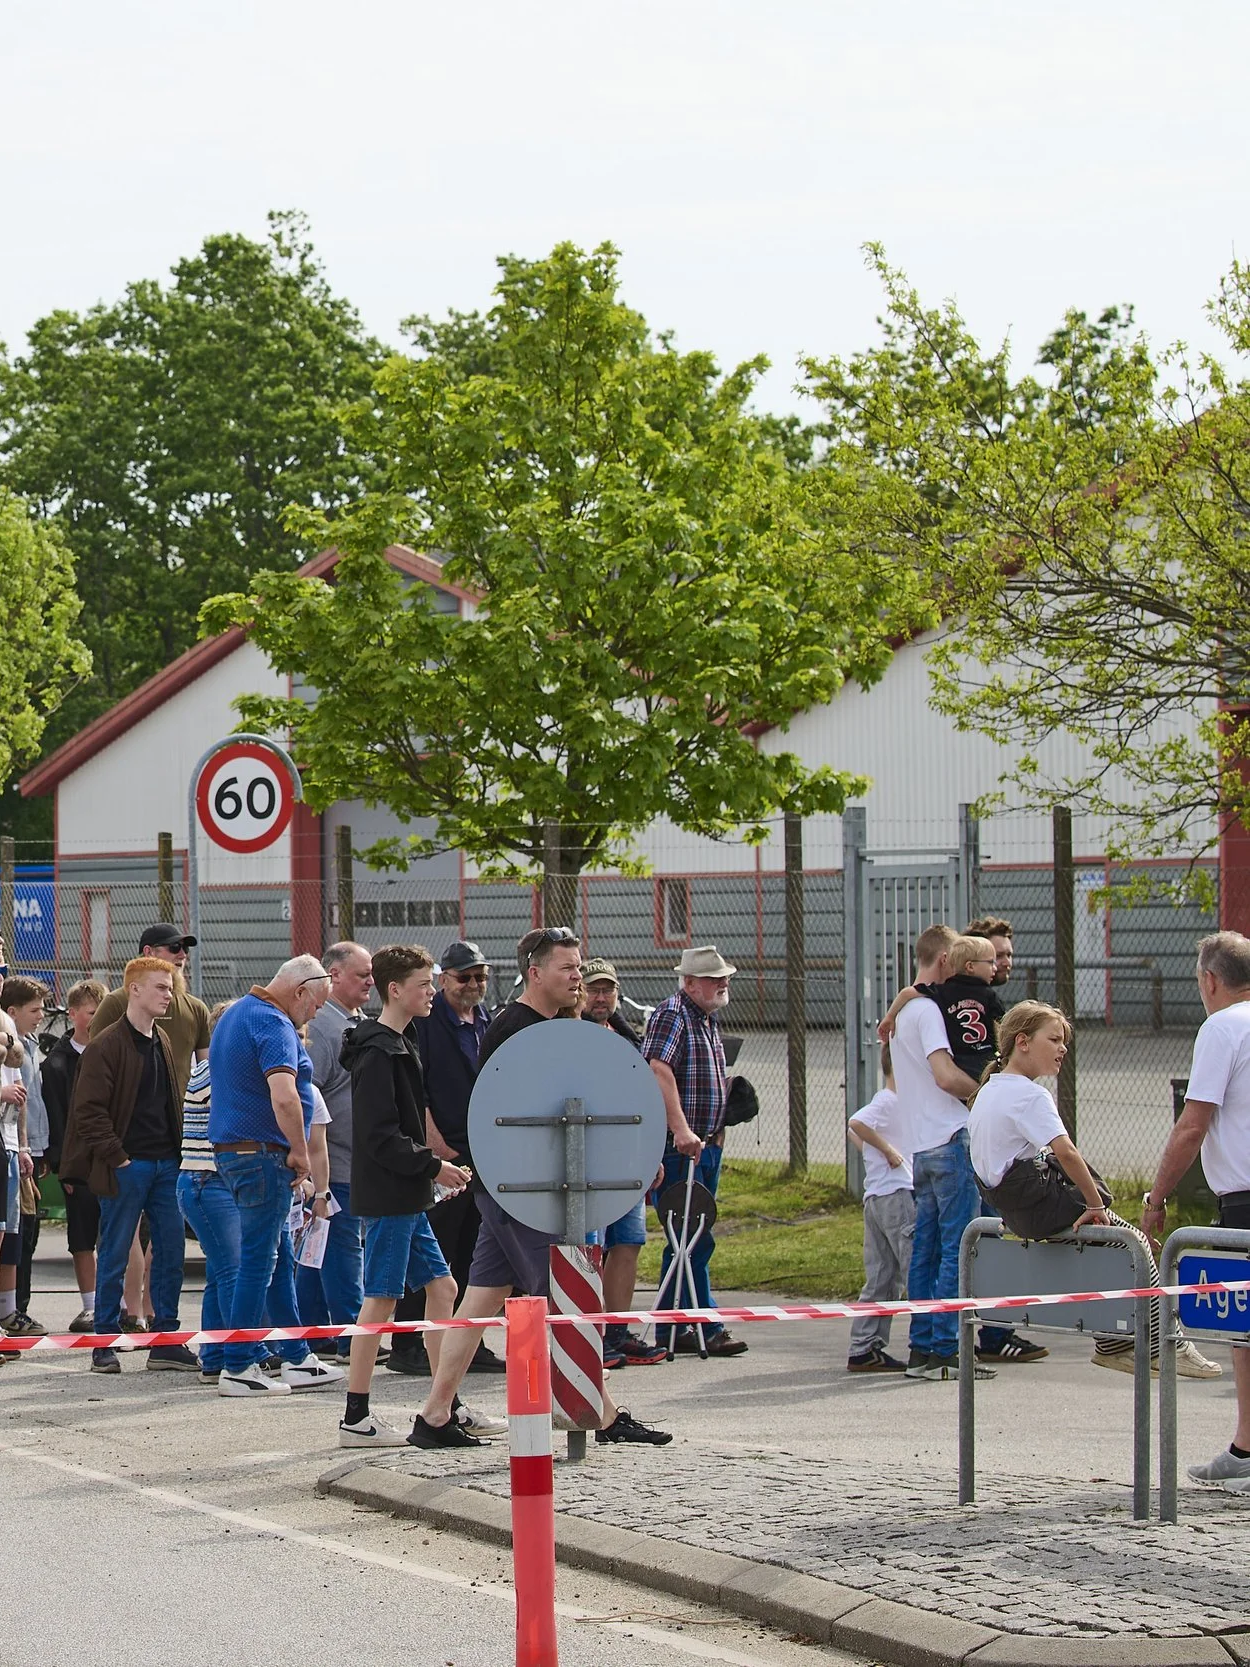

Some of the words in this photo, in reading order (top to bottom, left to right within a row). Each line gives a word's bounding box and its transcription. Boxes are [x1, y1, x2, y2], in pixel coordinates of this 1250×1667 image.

[214, 776, 276, 820] 60
[957, 1009, 987, 1044] 3
[1195, 1269, 1248, 1319] Age
